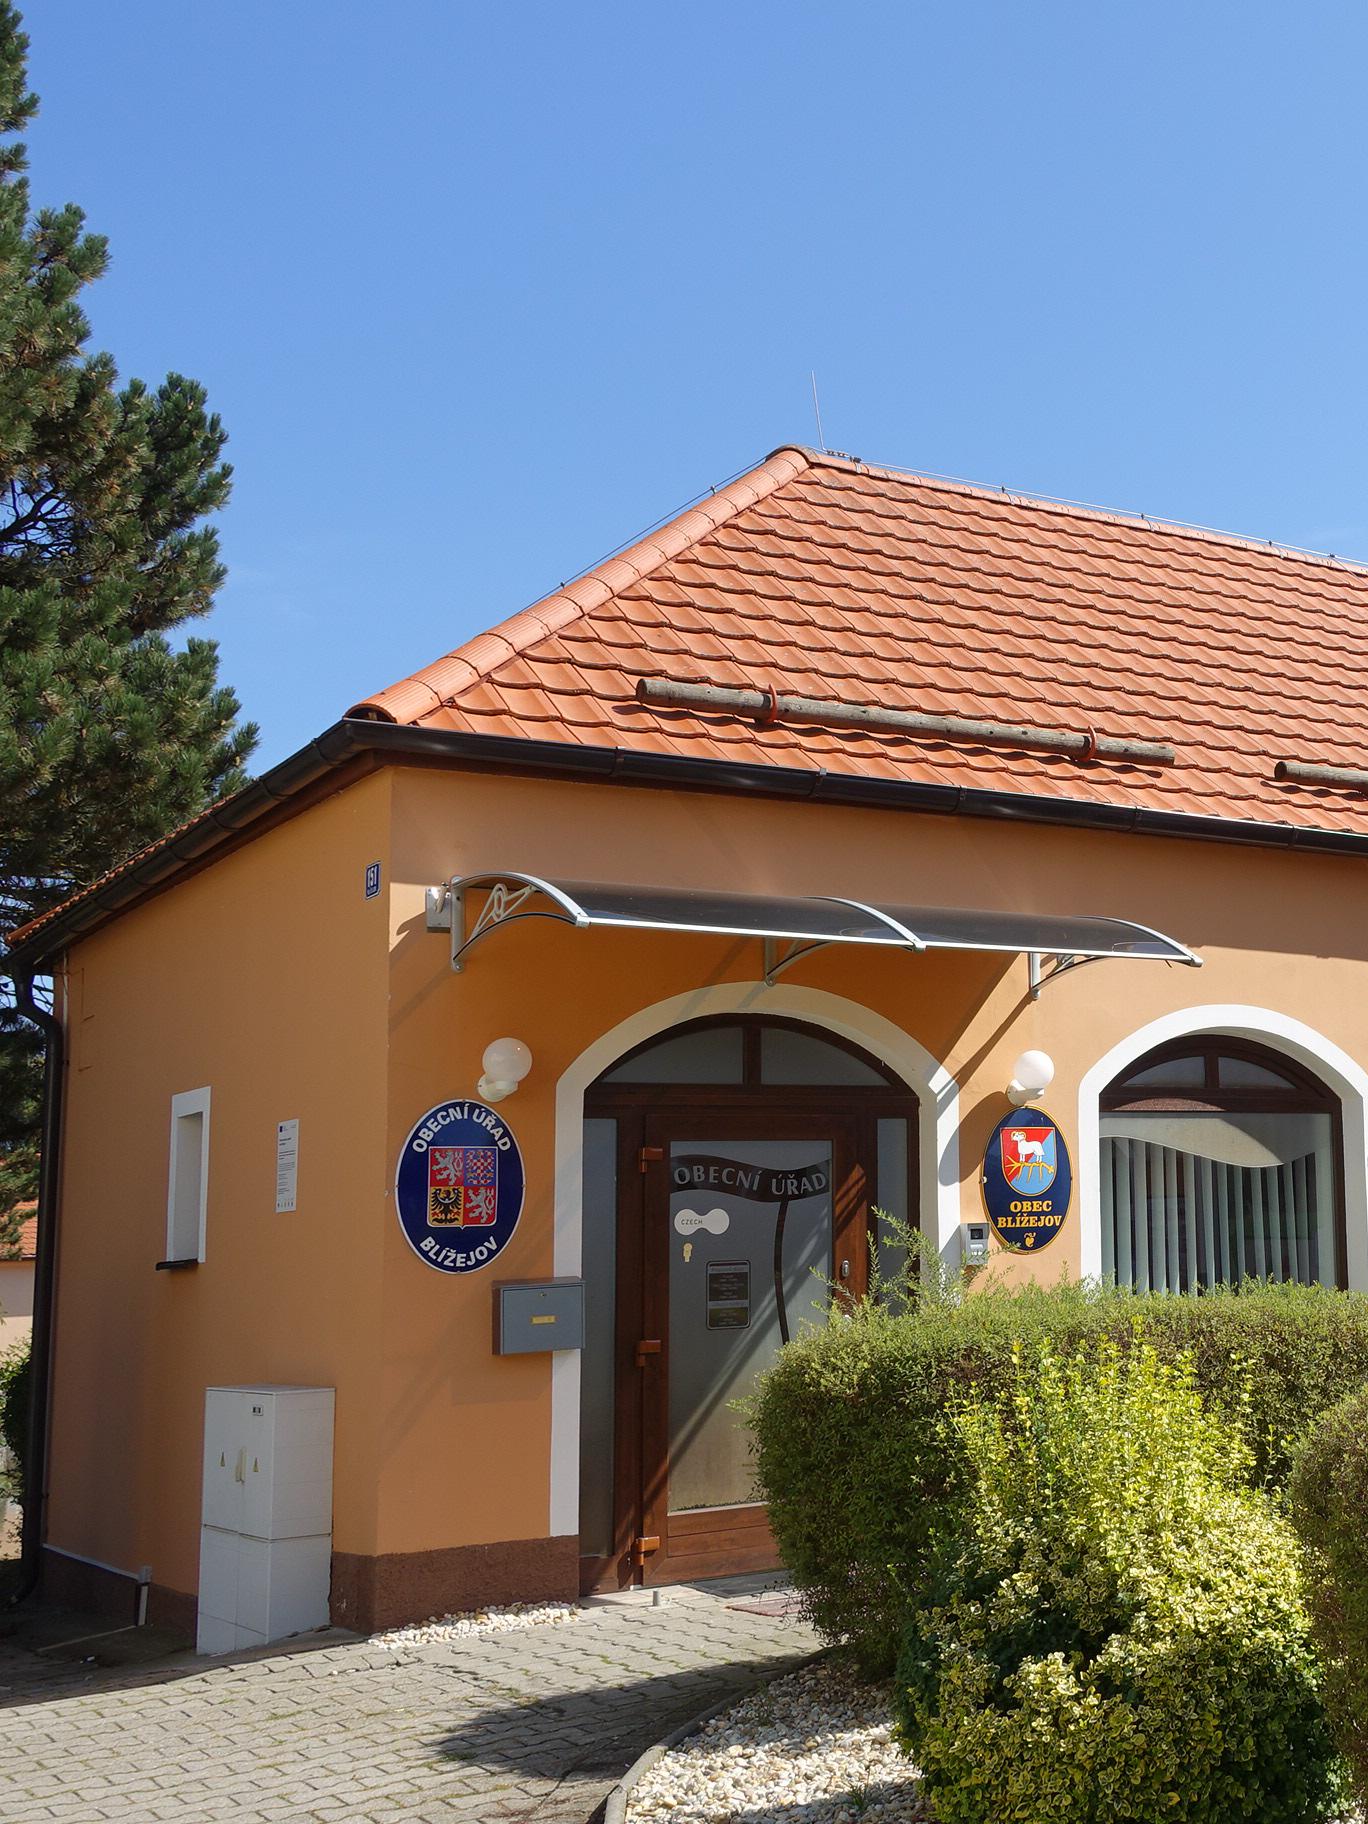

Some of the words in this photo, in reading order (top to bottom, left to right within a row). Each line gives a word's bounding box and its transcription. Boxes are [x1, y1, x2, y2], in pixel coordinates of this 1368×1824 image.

[412, 1103, 470, 1153] OBECNÍ
[472, 1107, 511, 1151] ÚŘAD
[673, 1165, 762, 1191] OBECNÍ
[771, 1173, 827, 1195] ÚŘAD
[997, 1213, 1062, 1228] BLÍŽEJOV
[1010, 1200, 1052, 1213] OBEC
[419, 1235, 498, 1267] BLÍŽEJOV
